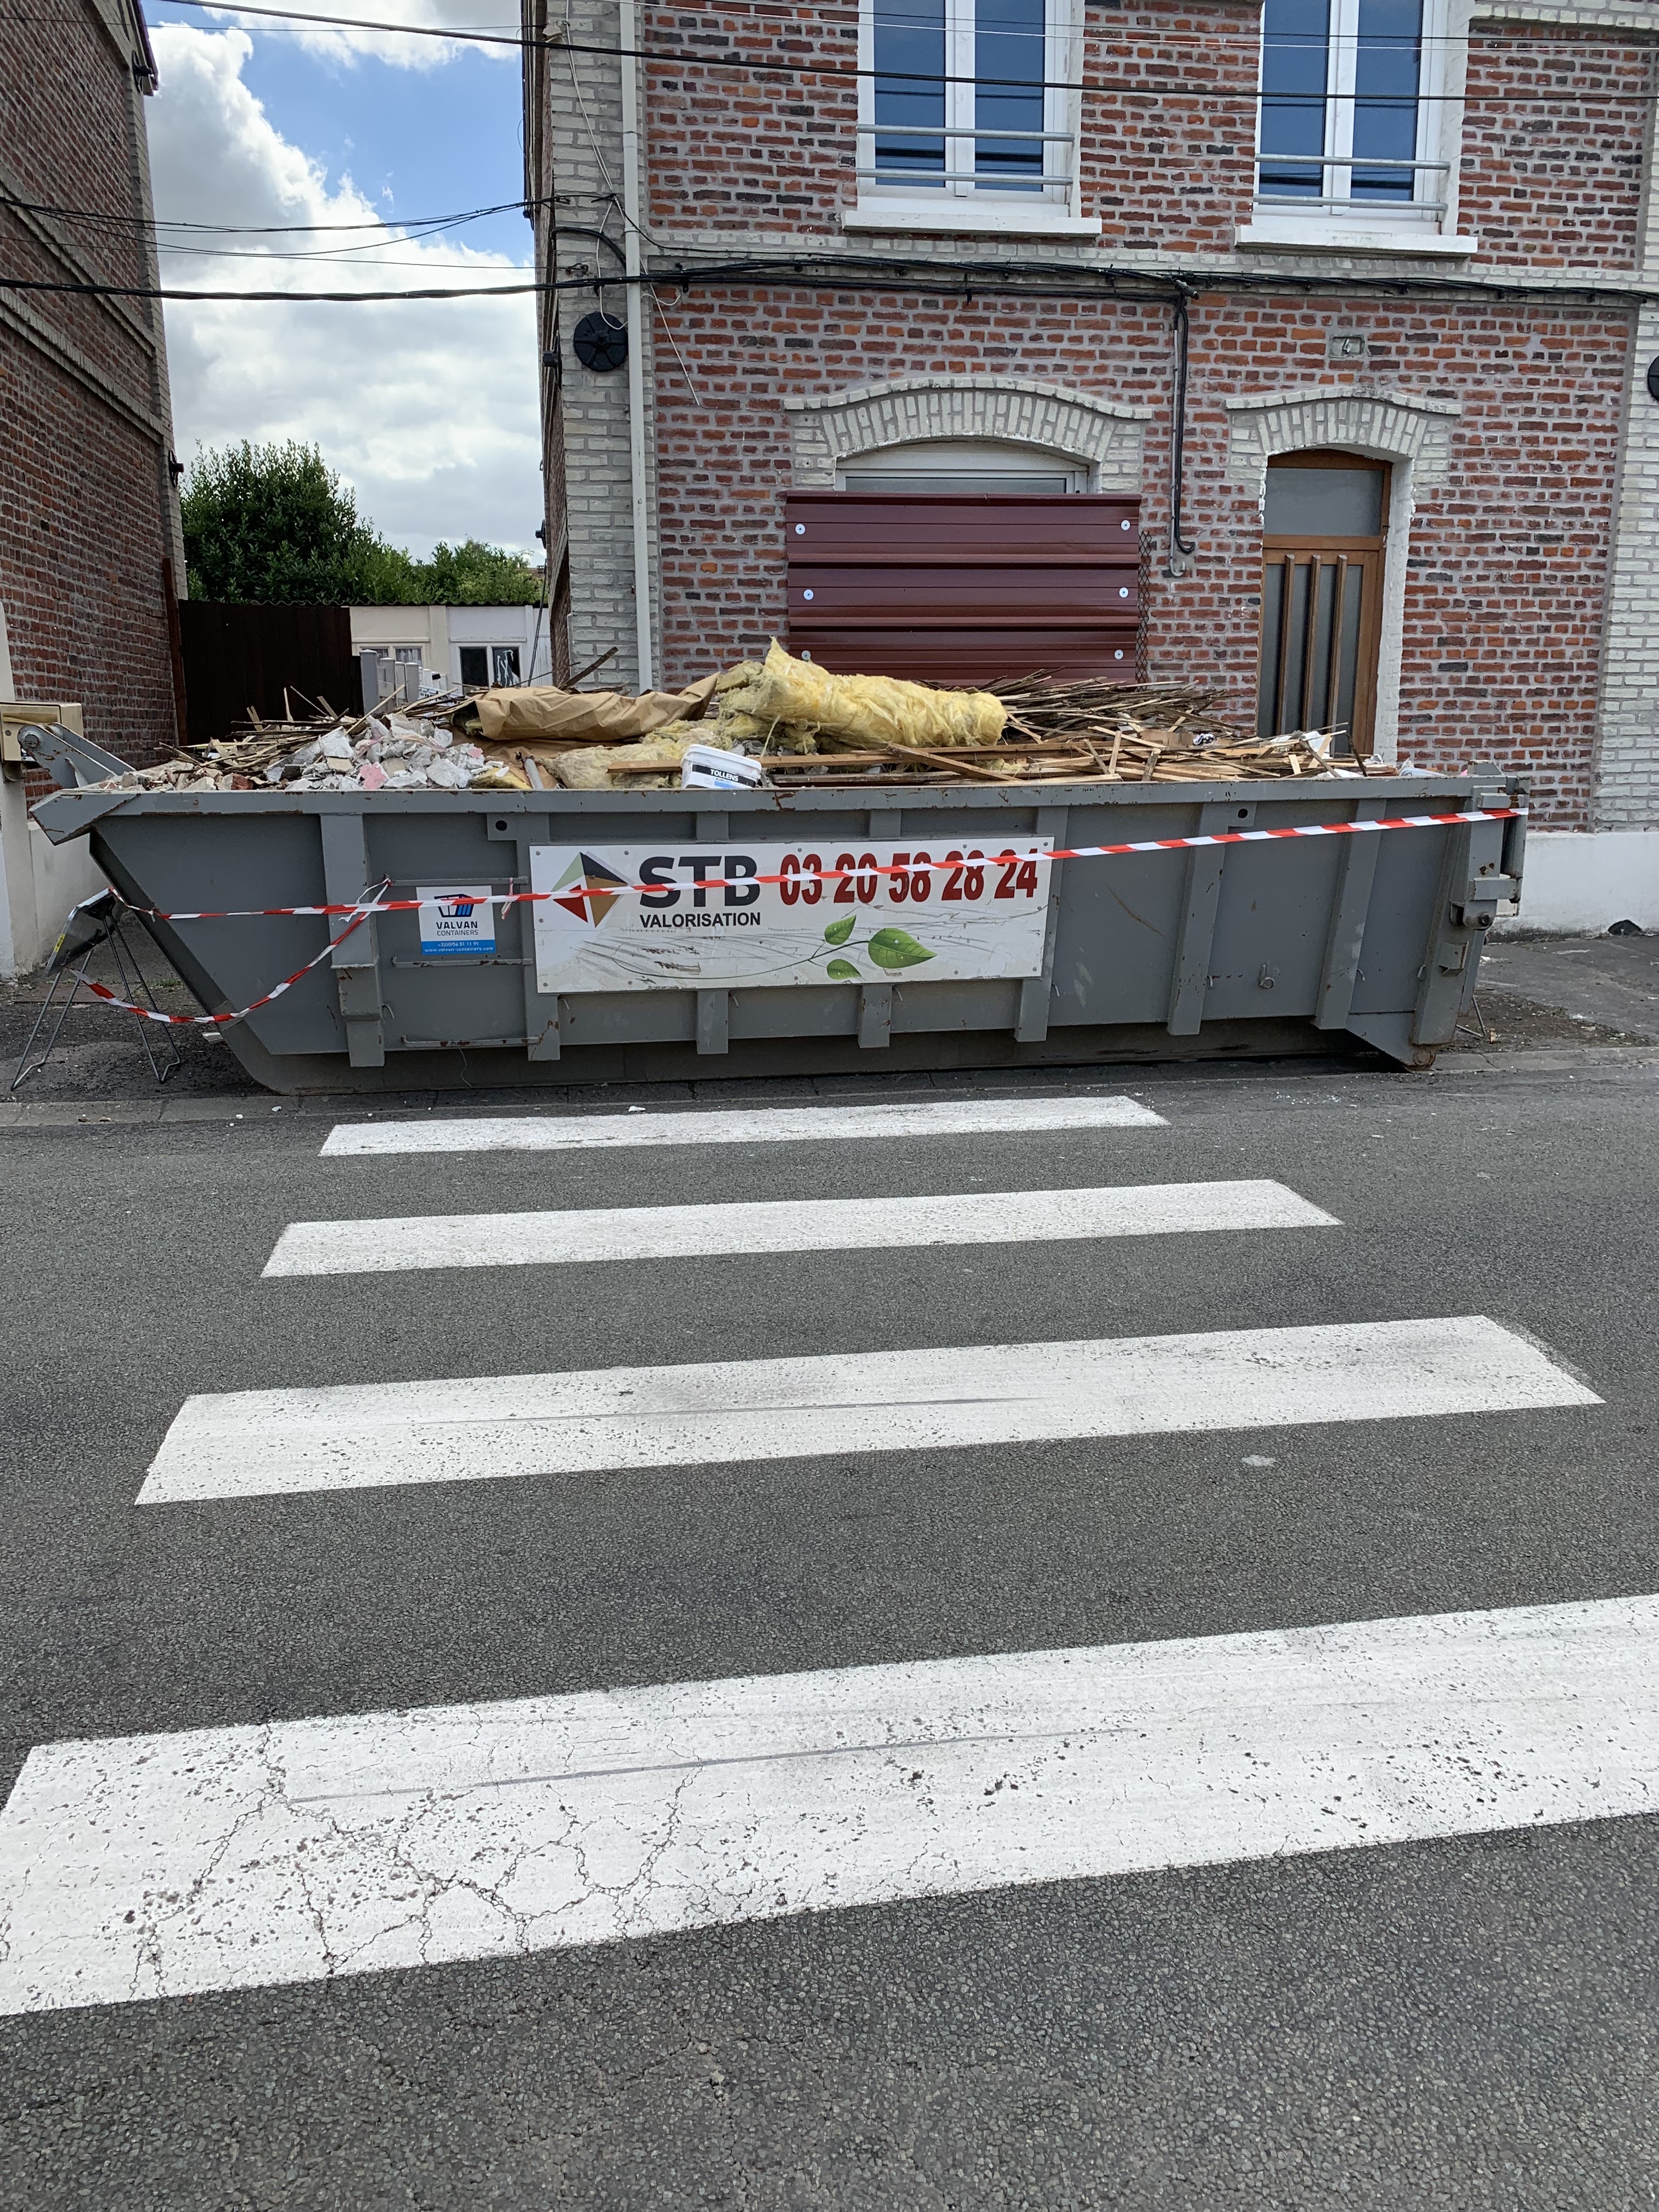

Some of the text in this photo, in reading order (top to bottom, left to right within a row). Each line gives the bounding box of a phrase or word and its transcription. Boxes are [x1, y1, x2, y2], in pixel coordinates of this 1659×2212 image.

[1342, 338, 1351, 354] 4
[710, 769, 738, 781] TOLLENS
[639, 855, 760, 909] STB
[780, 848, 1038, 905] 03 20 58 28 24
[436, 921, 478, 929] VALVAN
[639, 912, 760, 928] VALORISATION
